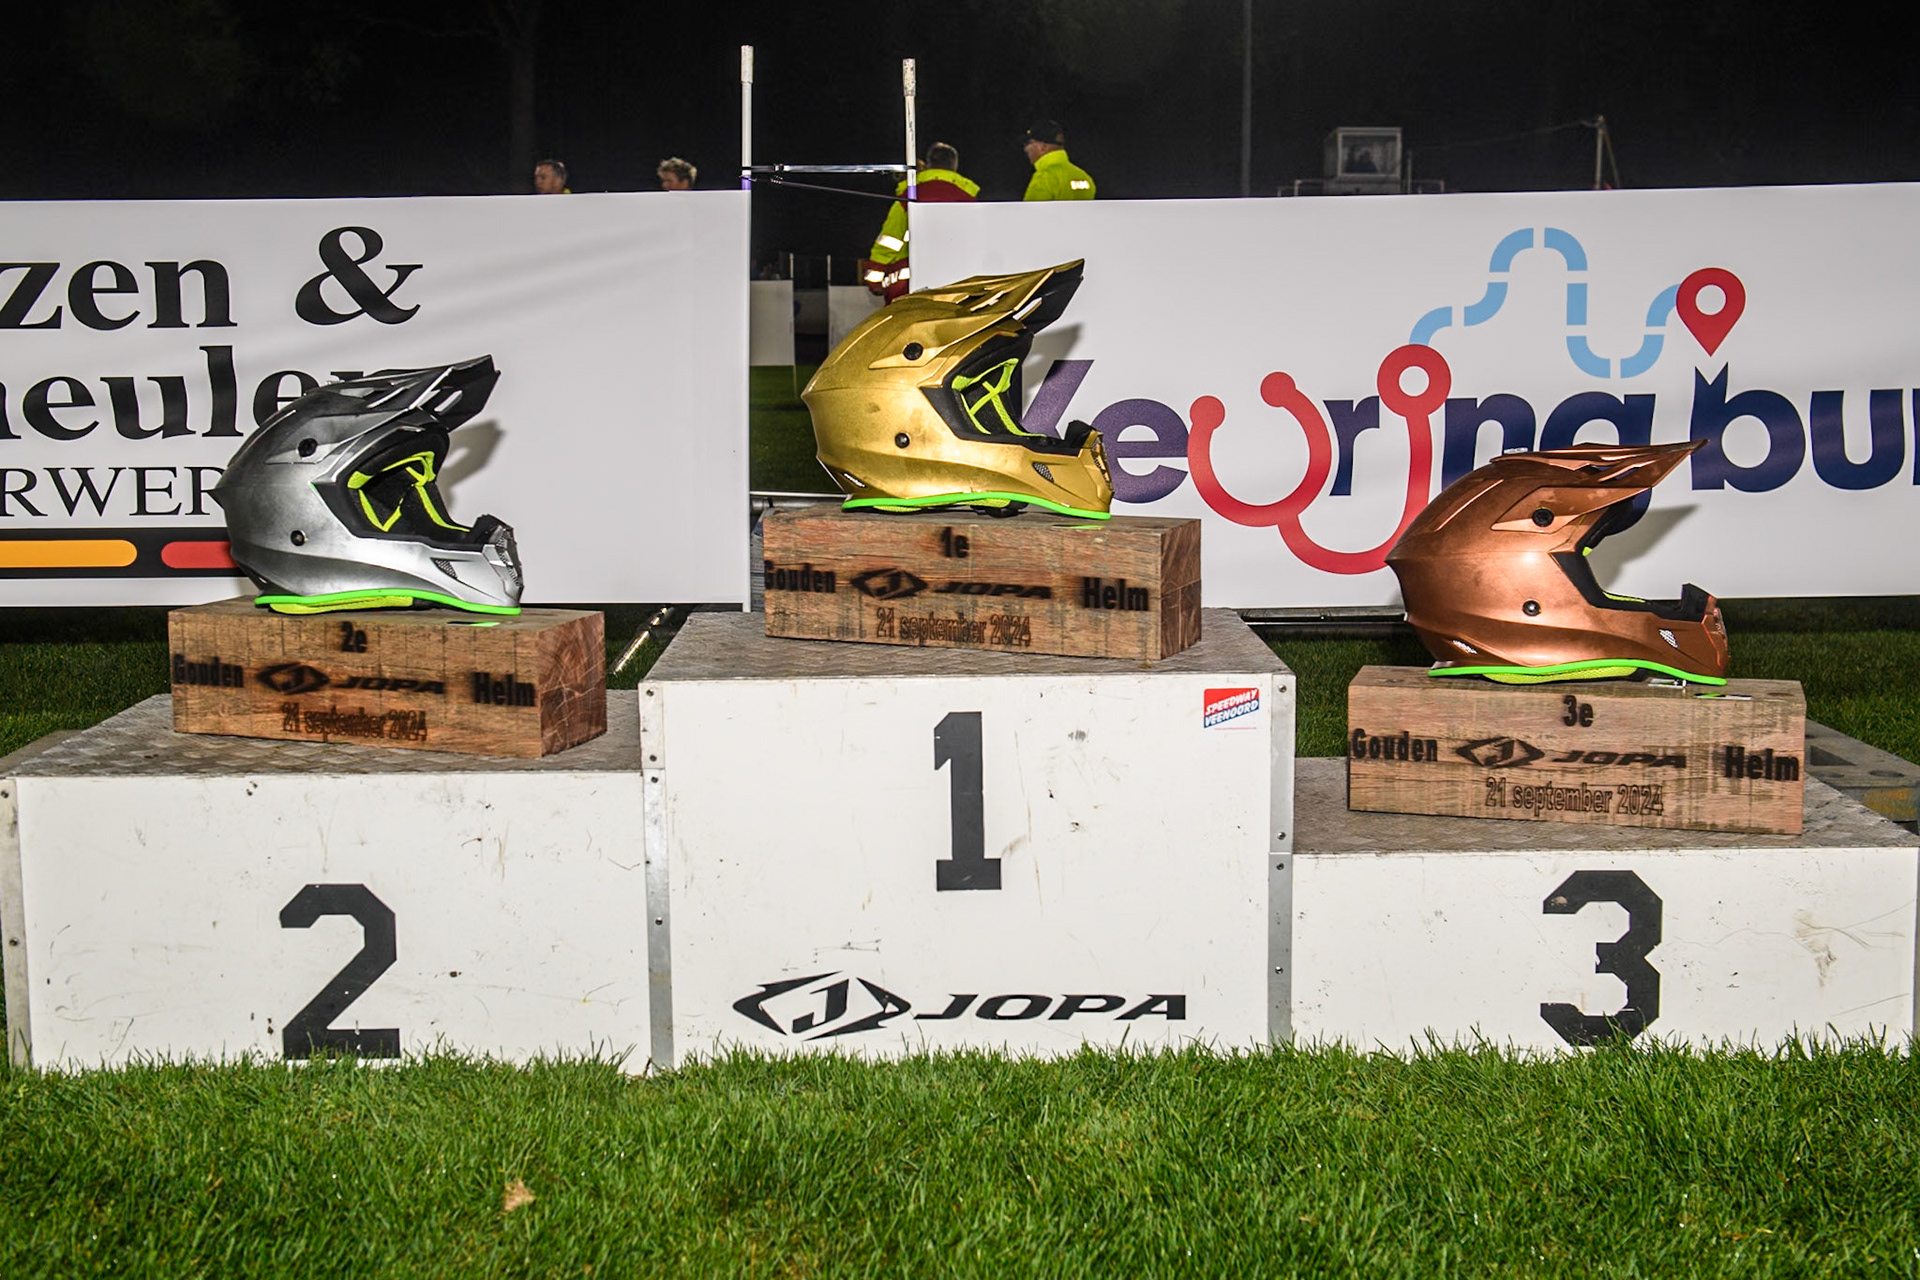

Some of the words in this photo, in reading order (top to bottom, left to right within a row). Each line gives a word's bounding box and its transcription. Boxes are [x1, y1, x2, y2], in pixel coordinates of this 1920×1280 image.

[295, 226, 423, 325] &
[1690, 362, 1920, 492] bu
[942, 527, 969, 558] 1e
[764, 560, 836, 593] Gouden
[935, 581, 1052, 599] JOPA
[1082, 577, 1149, 611] Helm
[341, 621, 368, 652] 2e
[876, 607, 895, 638] 21
[900, 612, 987, 646] september
[990, 614, 1031, 646] 2024
[173, 654, 243, 688] Gouden
[334, 676, 445, 694] JOPA
[473, 672, 536, 707] Helm
[282, 702, 299, 732] 21
[304, 706, 385, 742] september
[388, 709, 428, 741] 2024
[1204, 700, 1259, 727] VEENOORD
[1205, 689, 1258, 716] SPEEDWAY
[1563, 695, 1594, 727] 3e
[1352, 728, 1438, 762] Gouden
[1553, 750, 1687, 768] JOPA
[1725, 746, 1799, 781] Helm
[934, 711, 1002, 891] 1
[1486, 777, 1507, 807] 21
[1512, 781, 1613, 817] september
[1617, 784, 1664, 815] 2024
[280, 884, 400, 1058] 2
[1540, 869, 1663, 1046] 3
[913, 994, 1187, 1021] JOPA
